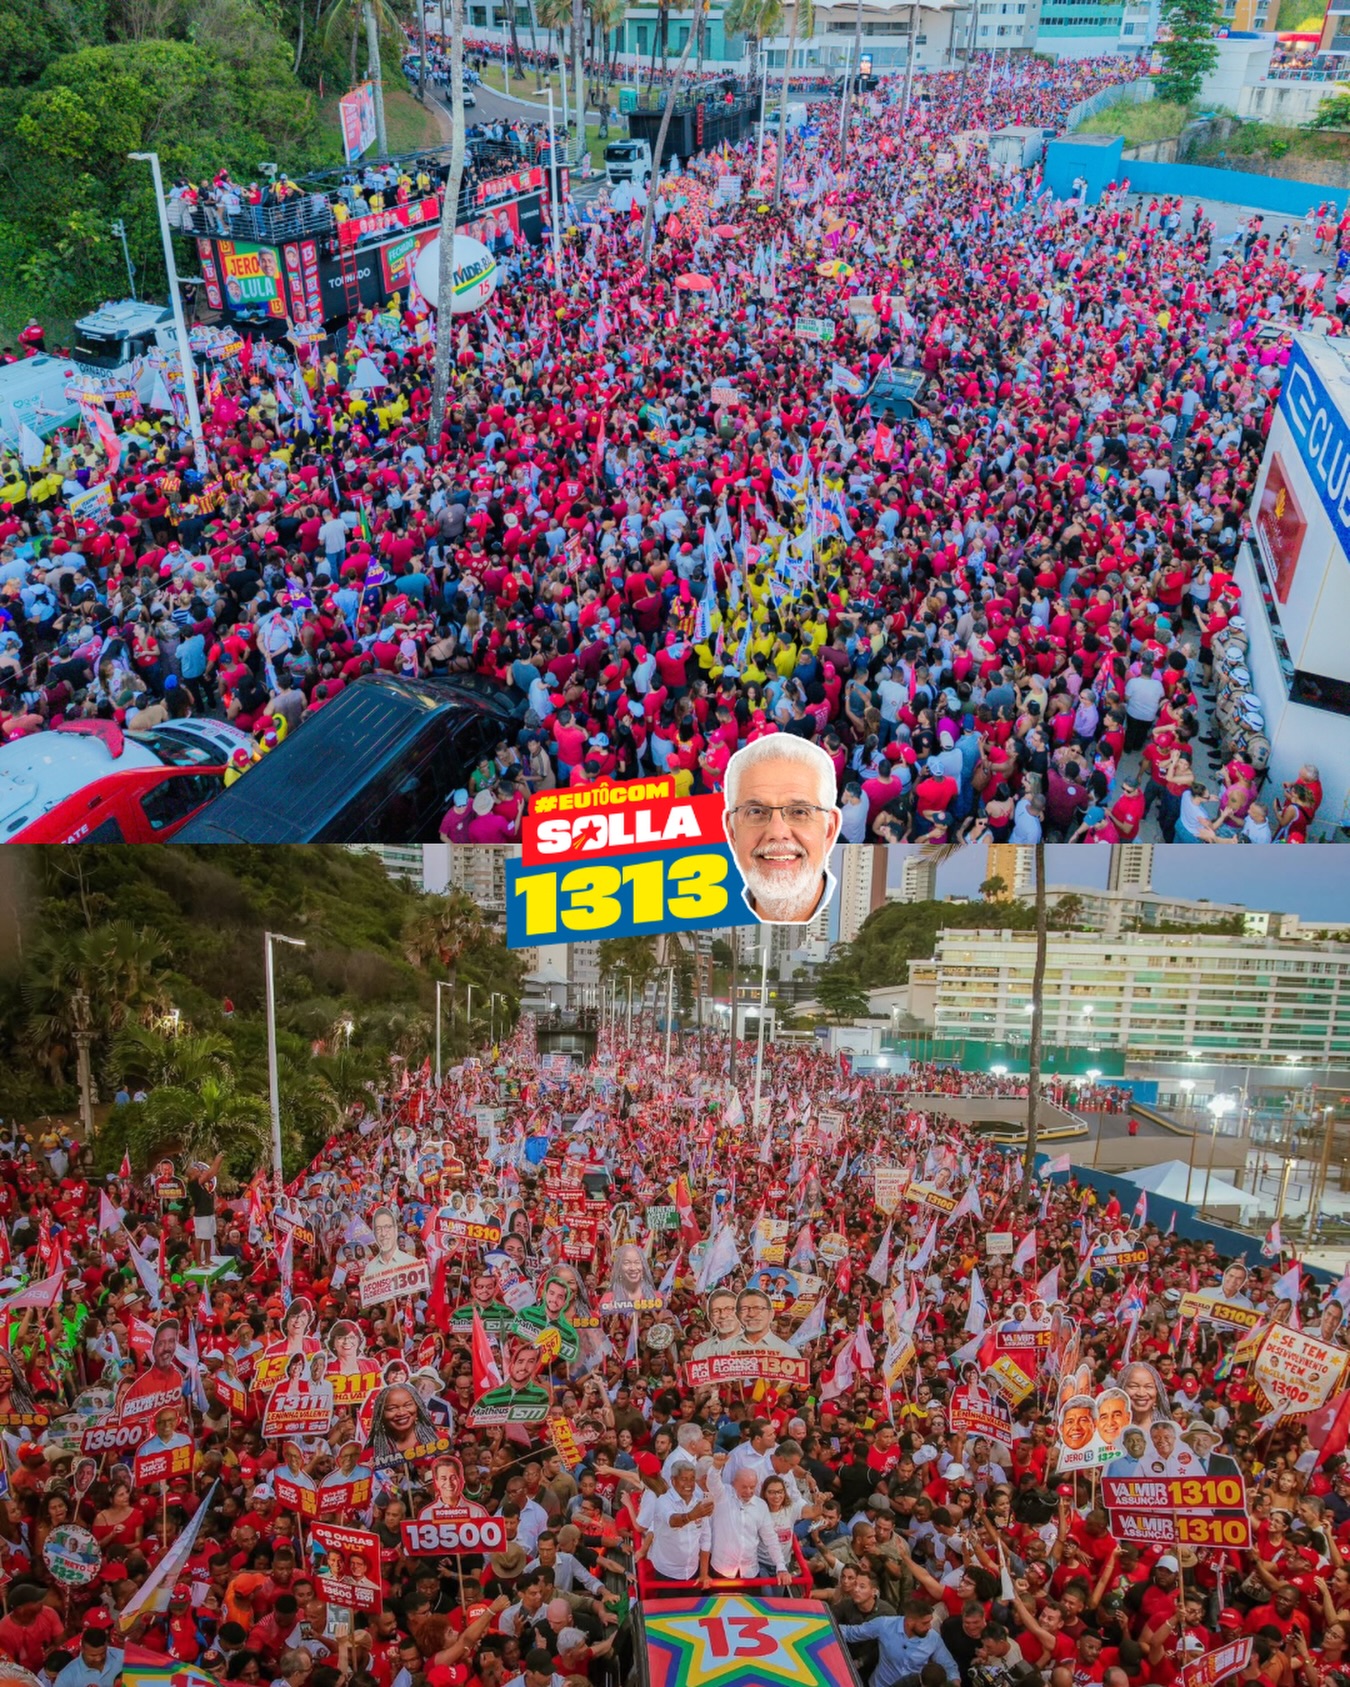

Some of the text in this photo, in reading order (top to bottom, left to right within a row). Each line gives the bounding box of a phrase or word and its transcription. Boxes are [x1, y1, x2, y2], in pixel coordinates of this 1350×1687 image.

[230, 256, 260, 277] JERO
[241, 277, 275, 299] LULA
[478, 279, 491, 297] 15
[272, 299, 282, 313] 13
[466, 1225, 500, 1241] 1310
[1117, 1251, 1147, 1264] 1310
[393, 1268, 426, 1291] 1301
[1214, 1305, 1257, 1326] 13100
[1280, 1335, 1328, 1361] SE TEM
[758, 1357, 806, 1378] 1301
[1280, 1361, 1306, 1377] TEM
[471, 1406, 509, 1416] Matheus
[84, 1425, 143, 1452] 13500
[1064, 1452, 1084, 1463] JERO
[1110, 1480, 1242, 1506] VALMIR 1310
[316, 1528, 375, 1547] OS CARAS
[406, 1521, 503, 1551] 13500
[1118, 1514, 1248, 1545] VALMIR 1310
[325, 1538, 366, 1553] DO VLT
[698, 1616, 779, 1658] 13
